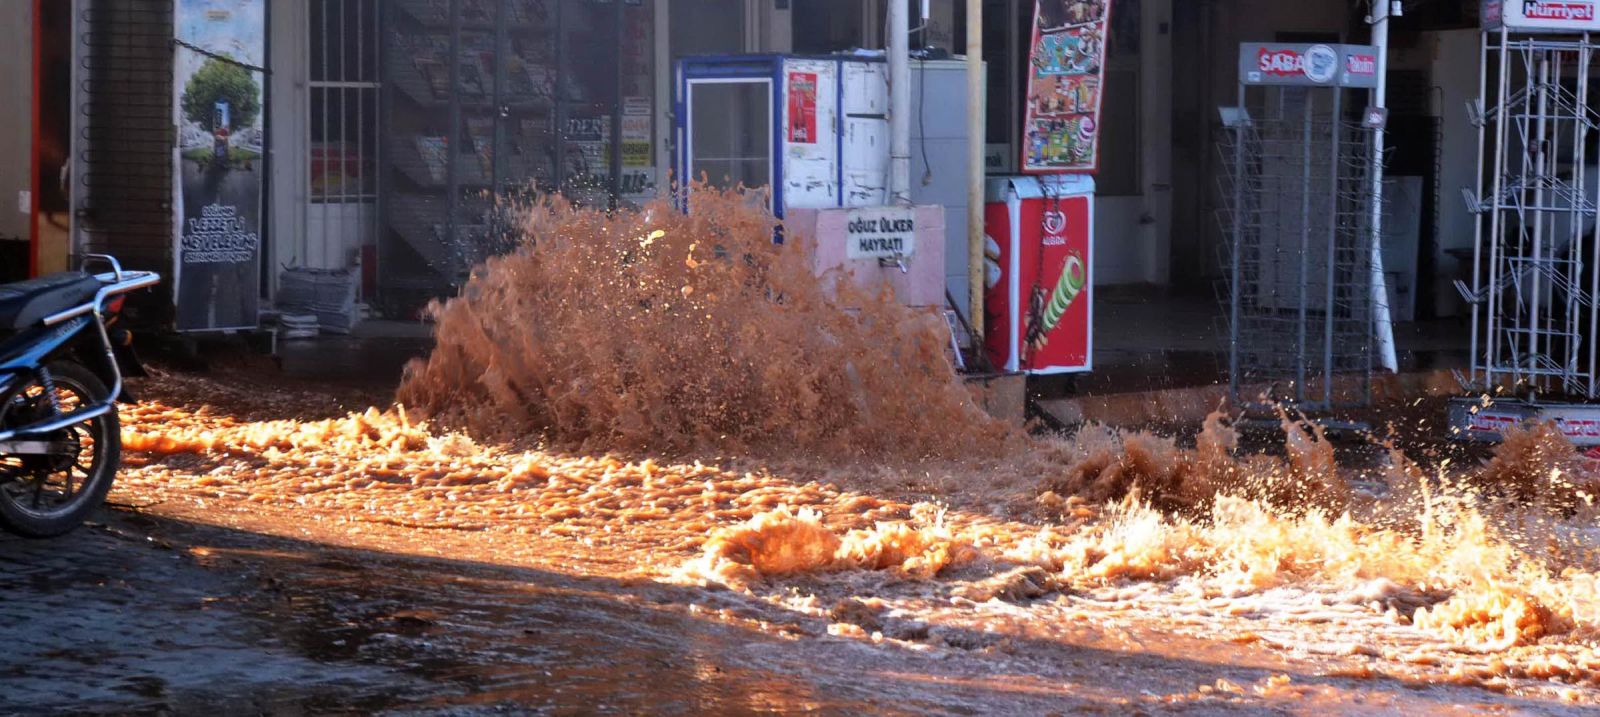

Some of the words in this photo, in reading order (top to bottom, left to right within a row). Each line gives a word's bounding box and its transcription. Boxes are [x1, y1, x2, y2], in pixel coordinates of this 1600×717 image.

[1524, 1, 1592, 20] Hürriyet
[1259, 53, 1305, 72] SABA
[848, 216, 877, 233] OĞUZ
[880, 217, 913, 233] ÜLKER
[860, 237, 902, 251] HAYRATI
